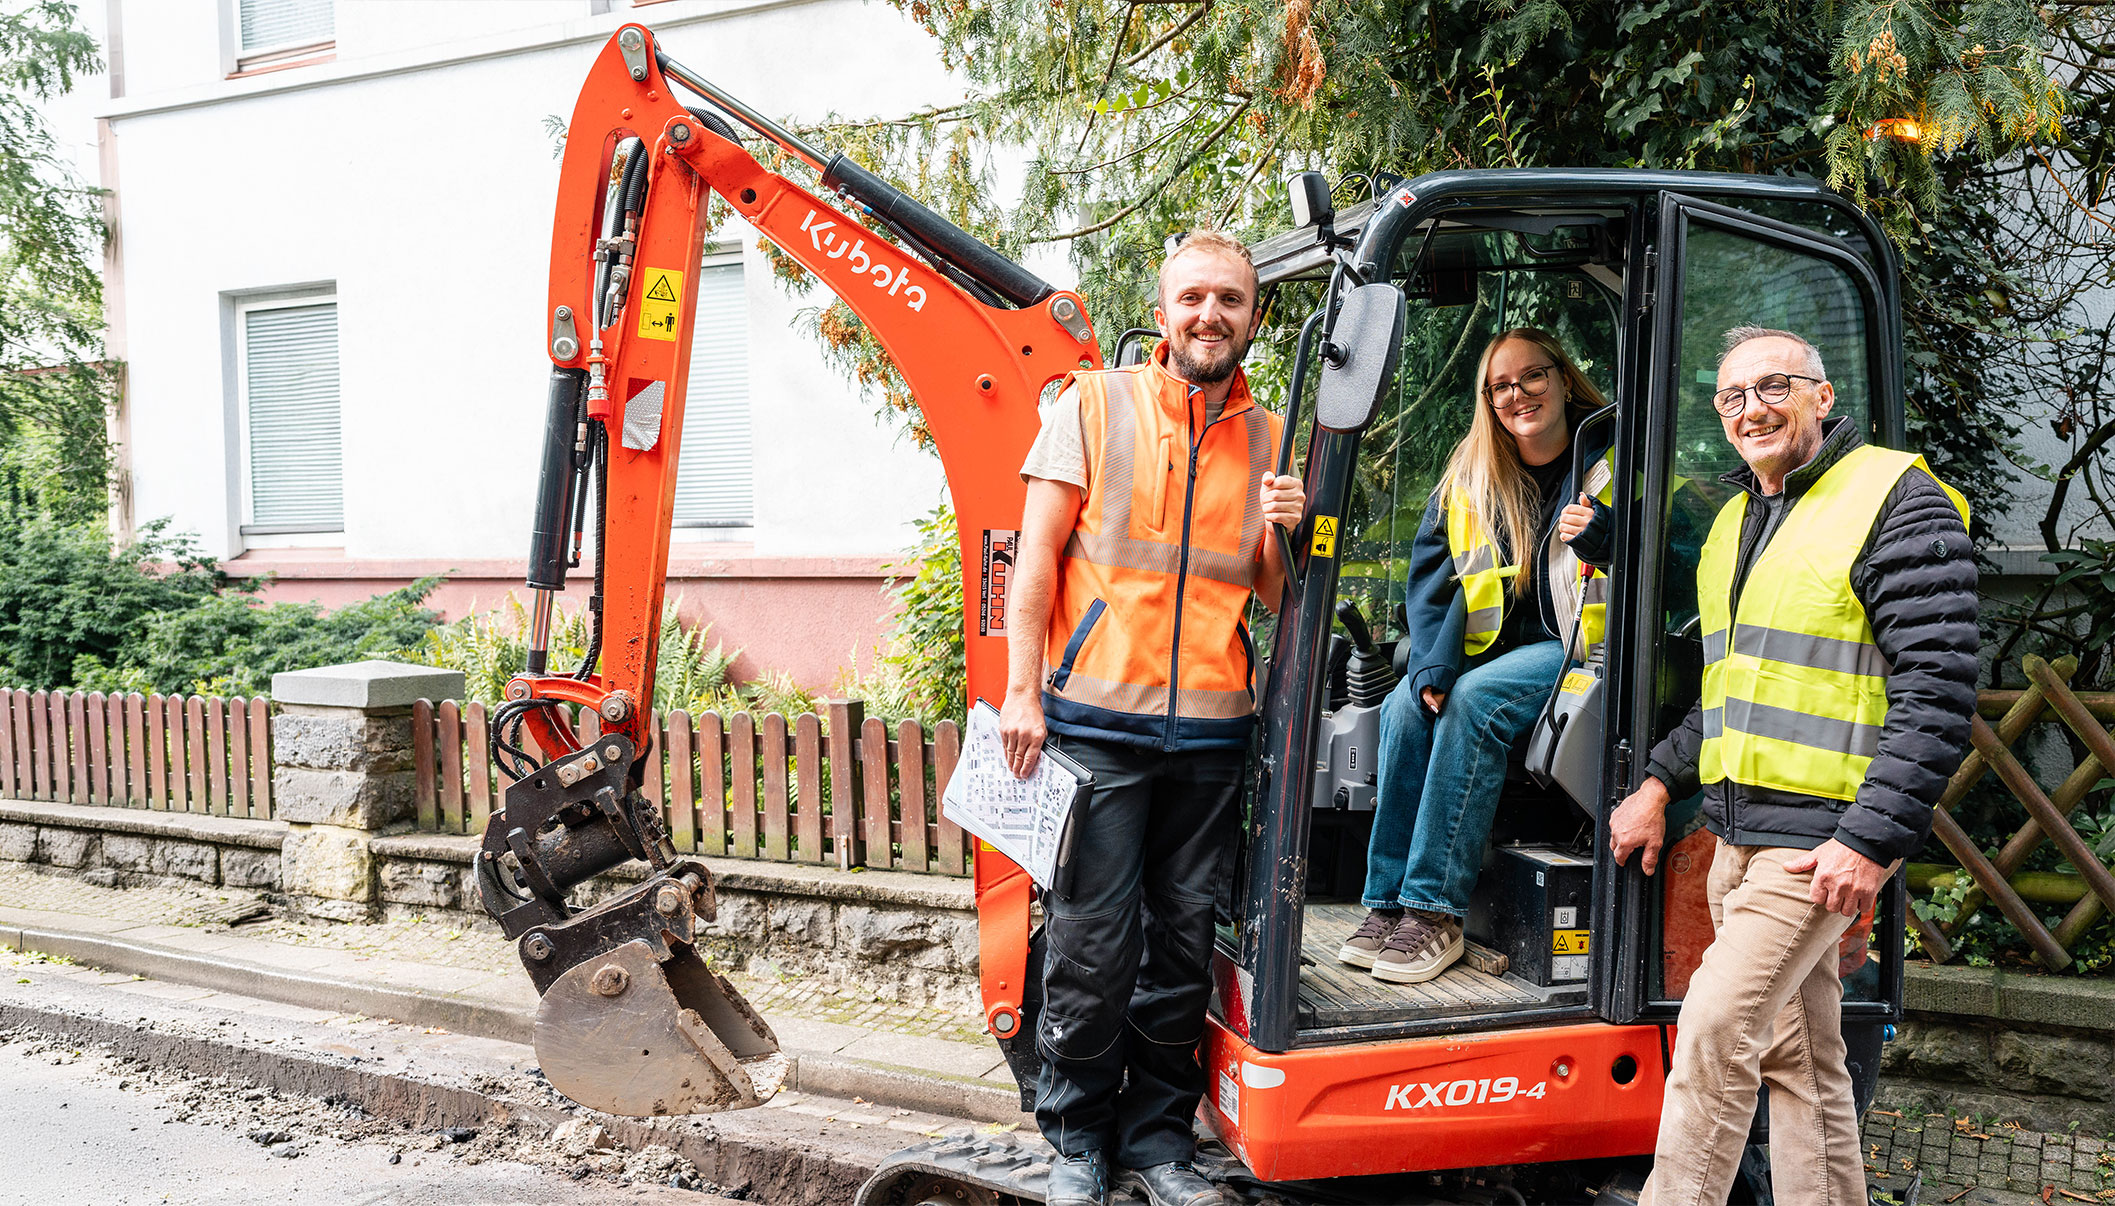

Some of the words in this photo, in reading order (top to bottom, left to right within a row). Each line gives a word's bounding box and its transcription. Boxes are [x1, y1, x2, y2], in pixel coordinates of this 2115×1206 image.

[800, 209, 927, 313] Kubota
[990, 541, 1013, 630] KUHN
[1383, 1076, 1547, 1111] KX019-4
